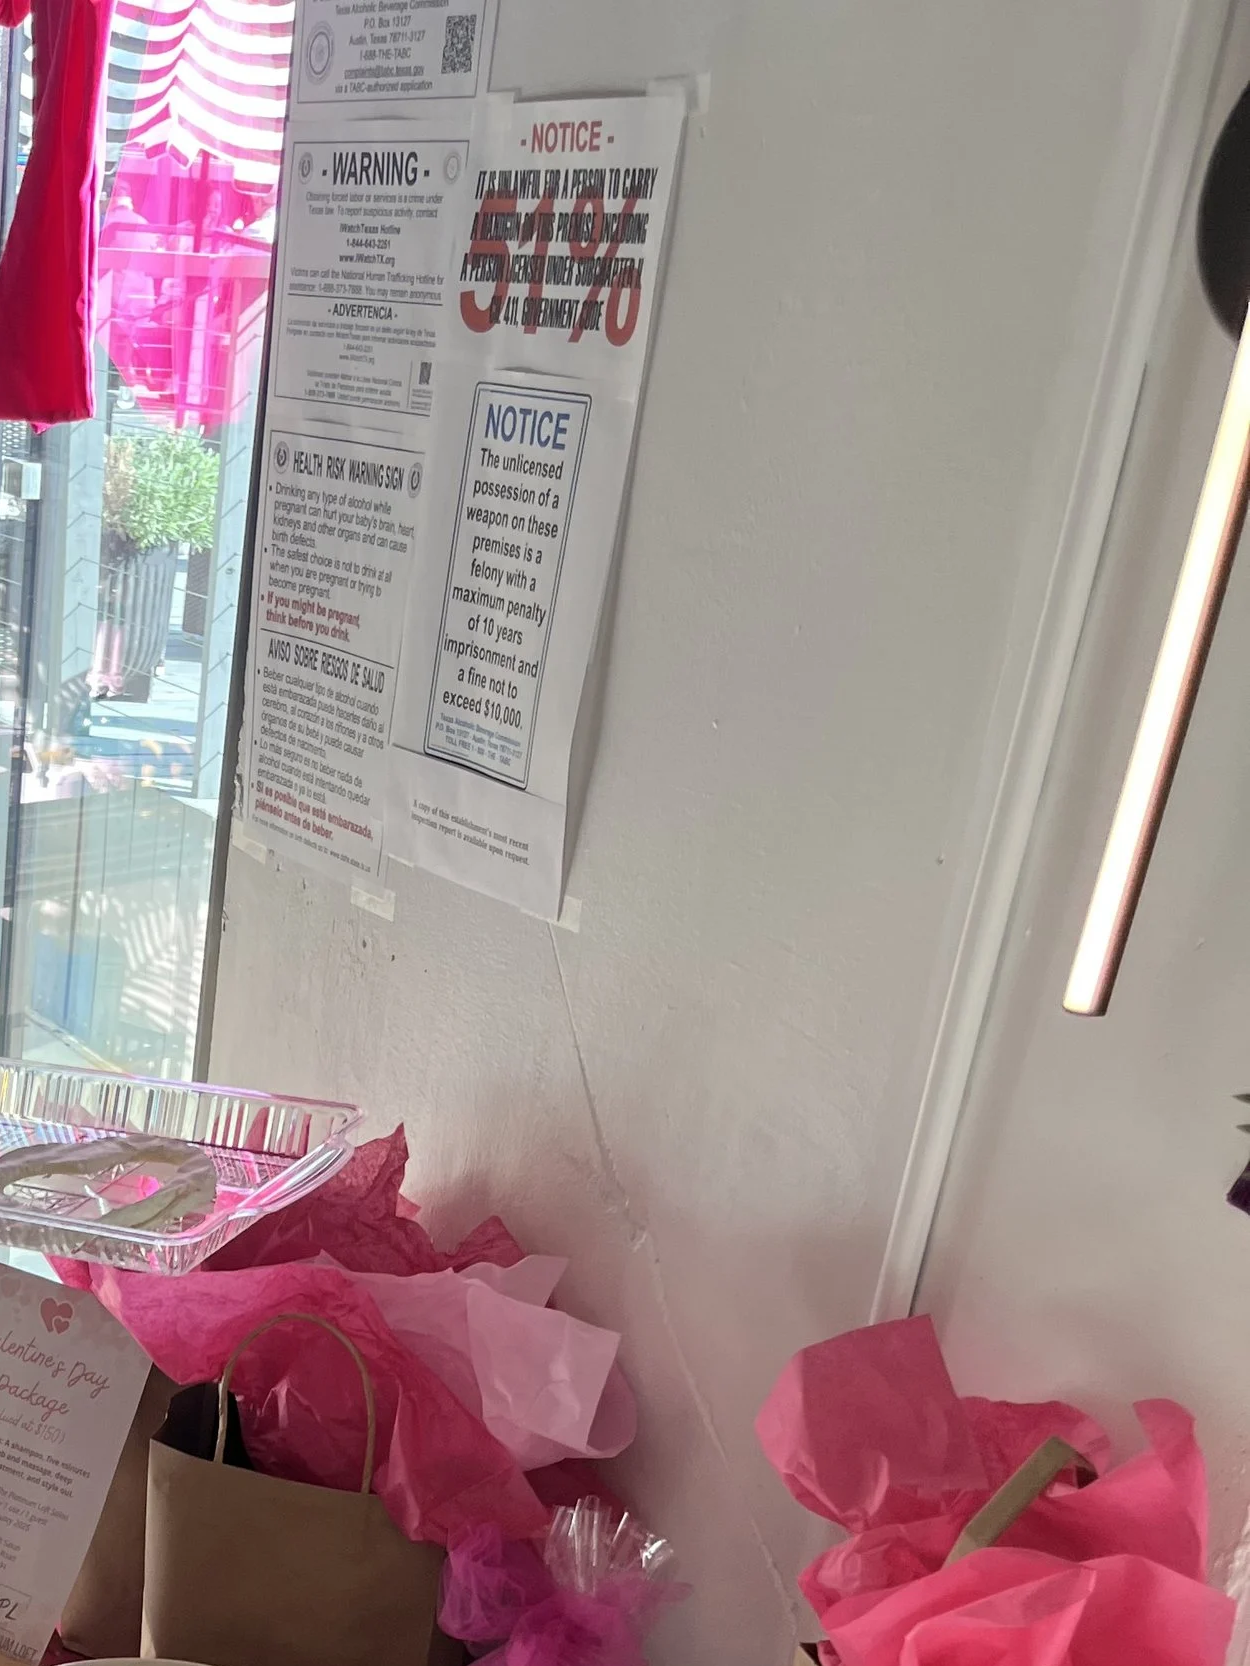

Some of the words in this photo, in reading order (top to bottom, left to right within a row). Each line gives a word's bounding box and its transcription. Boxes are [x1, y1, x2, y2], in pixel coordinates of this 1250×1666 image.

[531, 120, 601, 152] NOTICE
[333, 151, 417, 185] WARNING
[474, 166, 487, 199] IT
[486, 166, 497, 199] IS
[495, 166, 542, 200] UNLAWFUL
[542, 167, 561, 201] FOR
[560, 167, 570, 201] A
[569, 167, 607, 201] PERSON
[606, 168, 621, 202] TO
[621, 168, 658, 202] CARRY
[470, 211, 480, 240] A
[534, 211, 556, 242] THIS
[600, 212, 649, 244] INCLUDING
[456, 186, 650, 348] 51%
[459, 252, 469, 282] A
[469, 252, 506, 283] PERSON
[504, 253, 546, 285] LICENSED
[545, 254, 574, 286] UNDER
[332, 303, 392, 319] ADVERTENCIA
[520, 296, 579, 329] GOVERNMENT
[578, 298, 604, 330] CODE
[485, 404, 569, 449] NOTICE
[293, 451, 322, 476] HEALTH
[326, 455, 345, 479] RISK
[348, 459, 383, 487] WARNING
[384, 465, 404, 490] SIGN
[480, 447, 499, 468] The
[502, 454, 563, 479] unlicensed
[275, 481, 305, 501] Drinking
[306, 490, 320, 504] any
[322, 491, 337, 506] type
[338, 493, 347, 506] of
[347, 495, 372, 510] alcohol
[373, 500, 391, 515] while
[472, 480, 535, 503] possession
[537, 487, 551, 506] of
[551, 494, 559, 509] a
[273, 500, 307, 515] pregnant
[308, 506, 321, 517] can
[322, 506, 337, 520] hurt
[337, 511, 354, 524] your
[355, 512, 377, 531] baby's
[466, 506, 508, 528] weapon
[511, 515, 525, 531] on
[527, 514, 558, 538] these
[271, 529, 288, 542] birth
[273, 512, 301, 532] kidneys
[302, 520, 316, 532] and
[317, 522, 336, 536] other
[337, 527, 360, 542] organs
[361, 532, 376, 545] and
[376, 536, 388, 547] can
[388, 539, 407, 553] cause
[271, 543, 285, 557] The
[286, 548, 308, 562] safest
[309, 552, 332, 567] choice
[333, 559, 340, 570] is
[341, 561, 352, 573] not
[353, 562, 360, 574] to
[361, 563, 376, 578] drink
[377, 569, 384, 581] at
[383, 570, 392, 583] all
[472, 535, 520, 558] premises
[523, 542, 532, 562] is
[535, 550, 542, 564] a
[268, 574, 296, 591] become
[269, 560, 289, 573] when
[290, 565, 304, 577] you
[305, 568, 317, 580] are
[318, 571, 348, 587] pregnant
[349, 579, 357, 589] or
[357, 579, 374, 598] trying
[374, 584, 381, 597] to
[470, 558, 503, 587] felony
[506, 569, 527, 589] with
[529, 577, 536, 591] a
[267, 590, 274, 604] If
[274, 595, 290, 608] you
[291, 598, 315, 615] might
[316, 601, 326, 616] be
[452, 586, 504, 610] maximum
[506, 600, 546, 627] penalty
[266, 608, 286, 624] think
[287, 613, 313, 631] before
[314, 622, 329, 635] you
[467, 614, 480, 631] of
[482, 616, 494, 636] 10
[495, 625, 522, 645] years
[267, 638, 290, 662] AVISO
[293, 644, 318, 670] SOBRE
[320, 652, 348, 680] RIESGOS
[350, 662, 360, 685] DE
[361, 666, 384, 693] SALUD
[443, 634, 515, 670] imprisonment
[517, 659, 538, 677] and
[457, 668, 464, 681] a
[467, 666, 486, 688] fine
[488, 678, 505, 695] not
[507, 681, 517, 699] to
[442, 691, 482, 713] exceed
[483, 699, 521, 728] $10,000.
[67, 1361, 110, 1398] Day
[47, 1455, 59, 1465] five
[14, 1641, 39, 1660] LOFT
